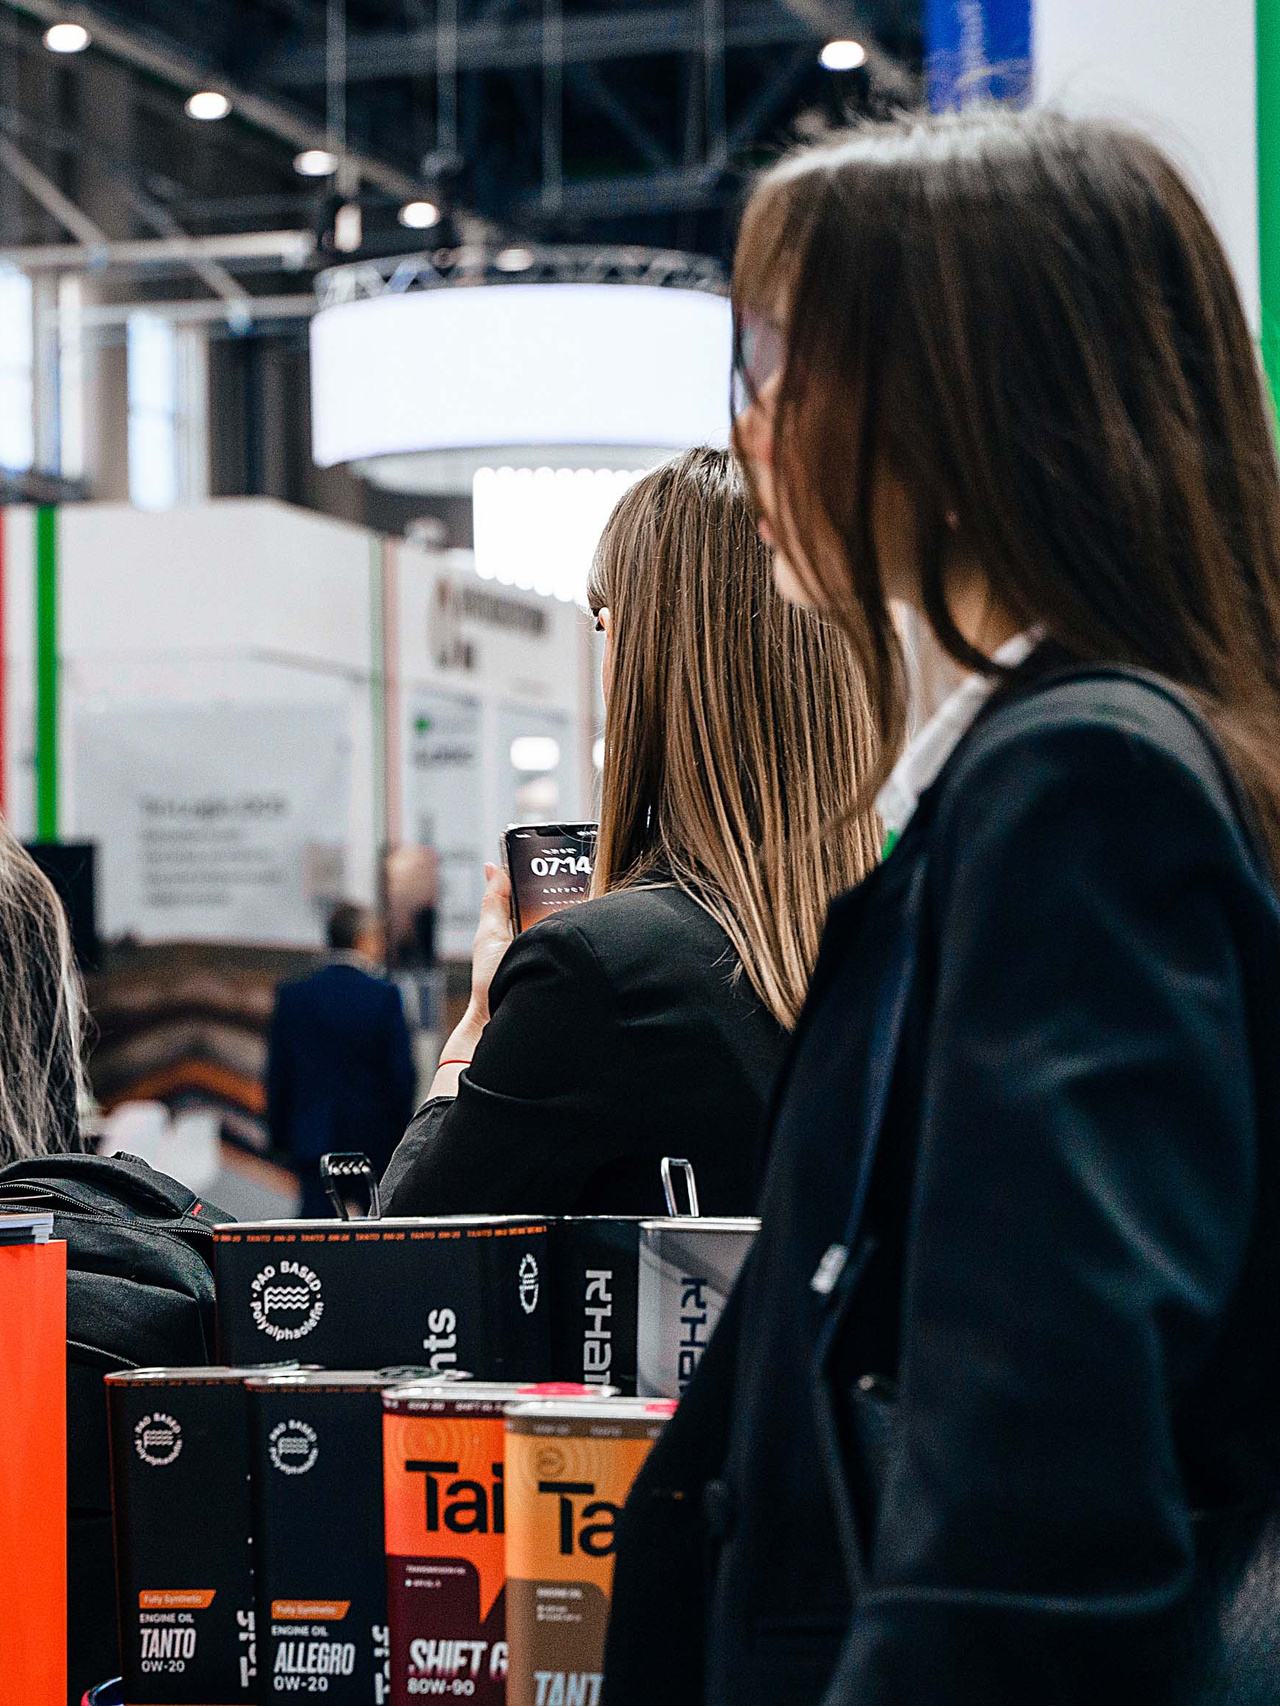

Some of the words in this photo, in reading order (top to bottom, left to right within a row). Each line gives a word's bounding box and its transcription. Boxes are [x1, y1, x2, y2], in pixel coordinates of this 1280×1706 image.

[531, 856, 593, 877] 07:14
[251, 1265, 276, 1292] PAO
[280, 1260, 322, 1292] BASED
[143, 1594, 162, 1604] Fully
[164, 1594, 202, 1604] Synthetic
[140, 1613, 176, 1623] ENGINE
[178, 1613, 194, 1623] OIL
[271, 1625, 309, 1636] ENGINE
[311, 1625, 329, 1637] OIL
[140, 1628, 196, 1659] TANTO
[141, 1660, 185, 1672] 0W-20
[273, 1641, 355, 1675] ALLEGRO
[408, 1638, 488, 1675] SHIFT
[273, 1676, 328, 1692] 0W-20
[407, 1677, 475, 1696] 80W-90
